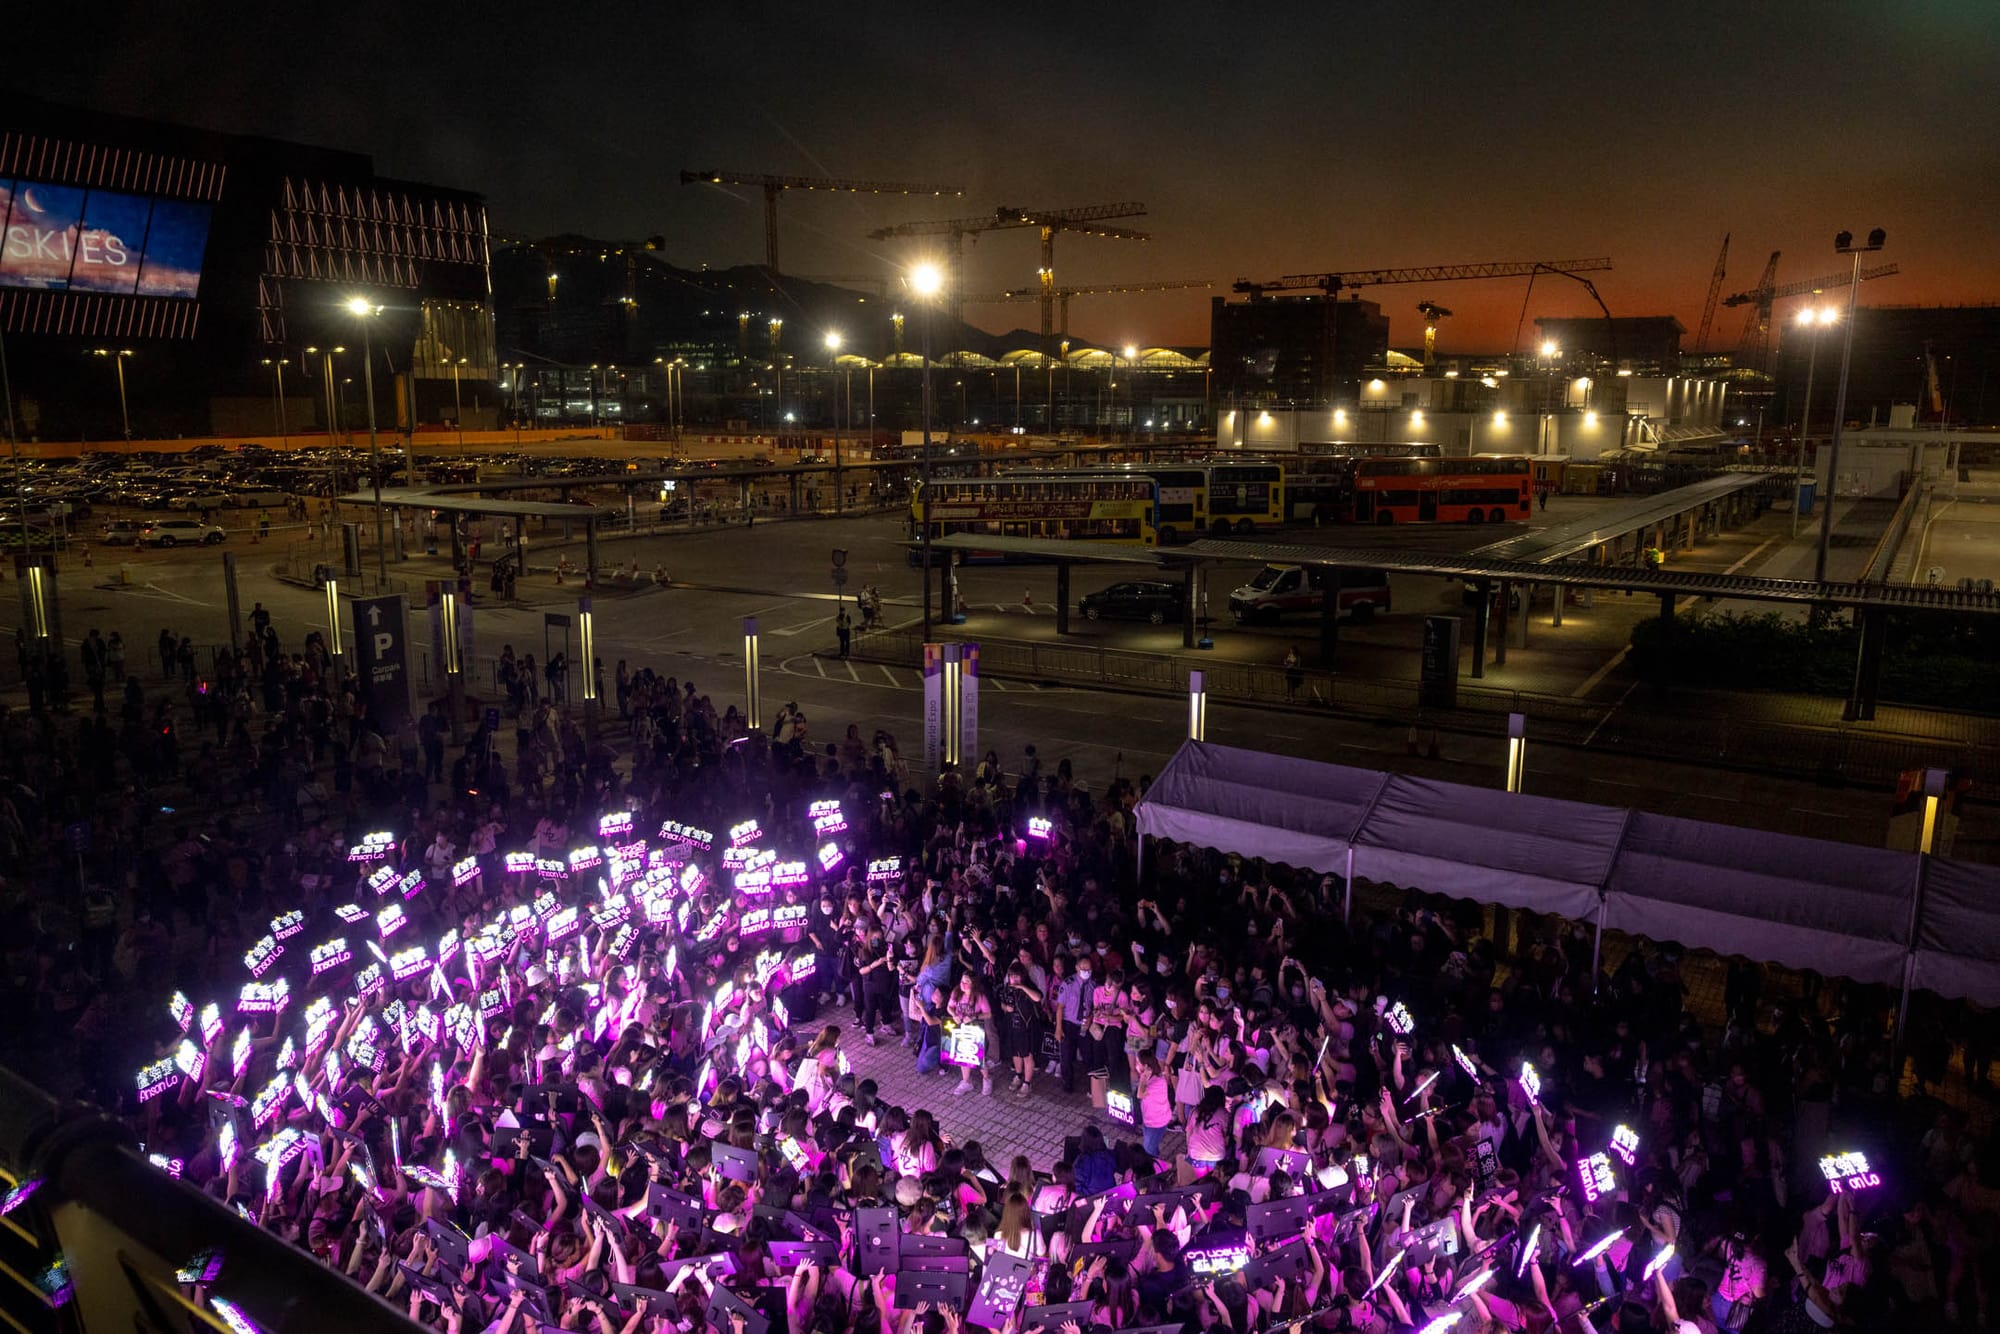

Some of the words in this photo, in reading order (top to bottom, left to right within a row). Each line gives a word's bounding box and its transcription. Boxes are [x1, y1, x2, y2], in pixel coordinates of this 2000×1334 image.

[8, 226, 128, 266] SKIES
[374, 632, 393, 660] P
[372, 663, 400, 676] Carpark
[348, 853, 373, 861] Anson
[571, 859, 591, 872] Anson
[590, 857, 602, 867] Lo
[773, 874, 797, 884] Anson
[796, 873, 809, 882] Lo
[867, 871, 890, 881] Anson
[890, 871, 901, 880] Lo
[774, 919, 796, 929] Anson
[796, 918, 808, 927] Lo
[275, 926, 298, 940] Anson
[252, 955, 276, 977] Anson
[272, 945, 284, 961] Lo
[313, 956, 339, 974] Anson
[337, 951, 351, 964] Lo
[394, 964, 419, 980] Anson
[417, 959, 431, 971] Lo
[237, 1000, 270, 1012] Anson
[140, 1080, 167, 1103] Anson
[165, 1075, 178, 1087] Lo
[255, 1099, 280, 1129] Anson
[278, 1085, 292, 1101] Lo
[1577, 1158, 1594, 1188] Anson
[1860, 1173, 1881, 1187] Lo
[1584, 1184, 1598, 1202] Lo
[1186, 1250, 1206, 1262] Lo
